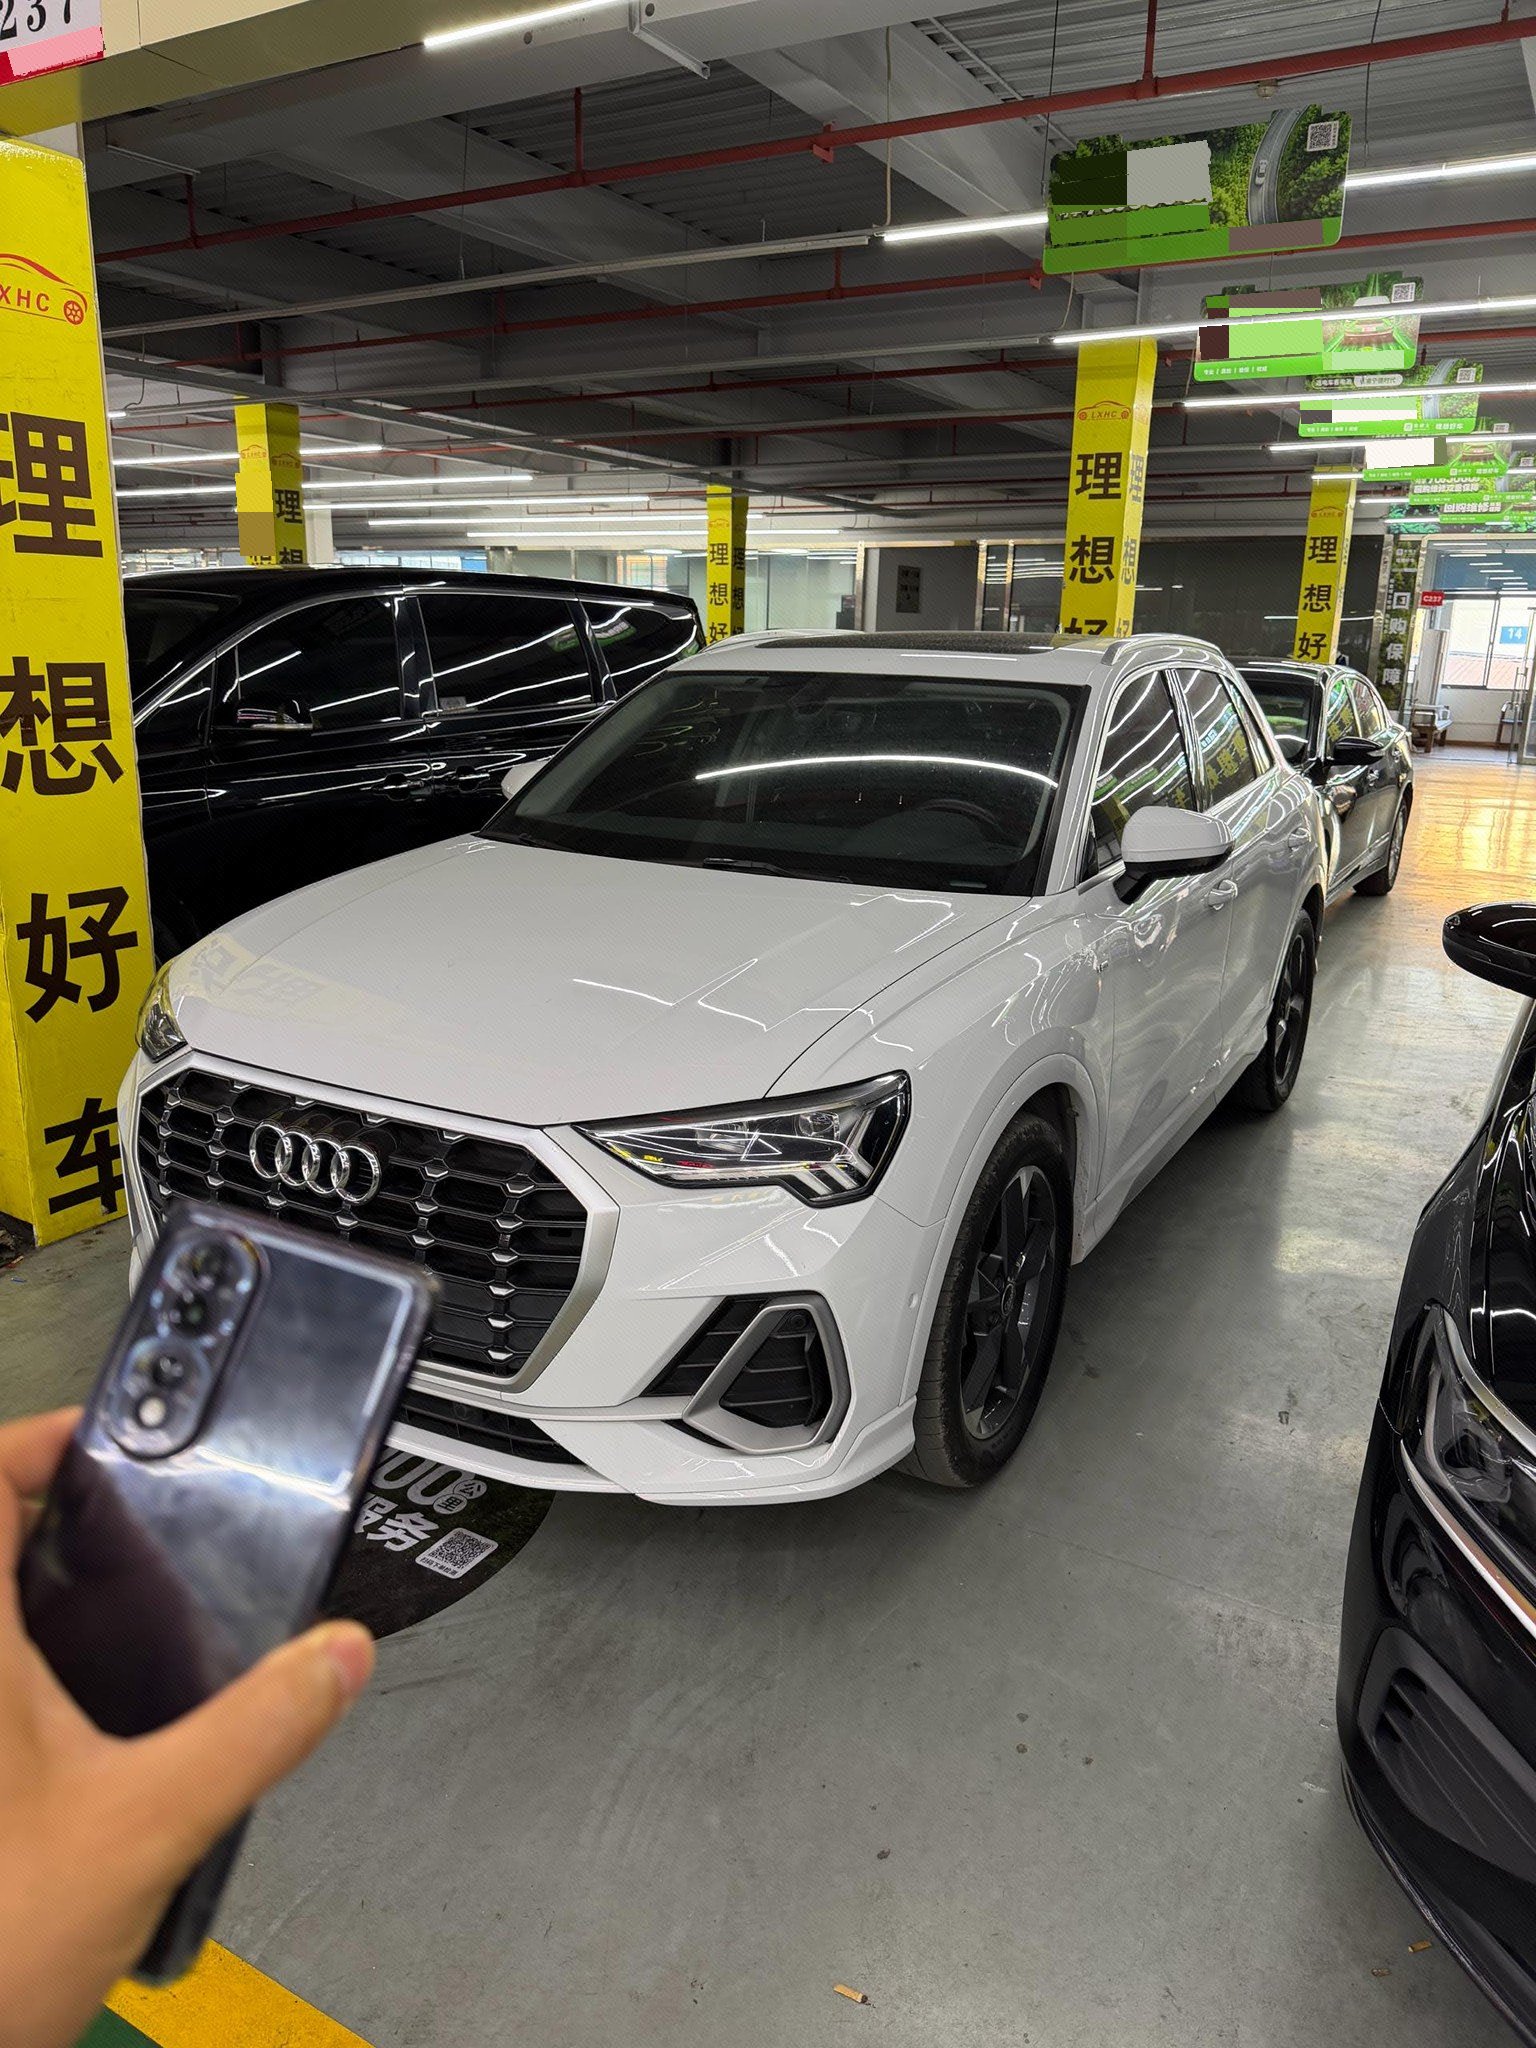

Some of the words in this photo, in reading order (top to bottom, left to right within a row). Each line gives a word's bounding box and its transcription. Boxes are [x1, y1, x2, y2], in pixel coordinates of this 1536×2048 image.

[1092, 411, 1117, 419] LXHC
[709, 543, 729, 644] 理想好
[1297, 536, 1338, 660] 理想好
[1508, 627, 1523, 640] 14
